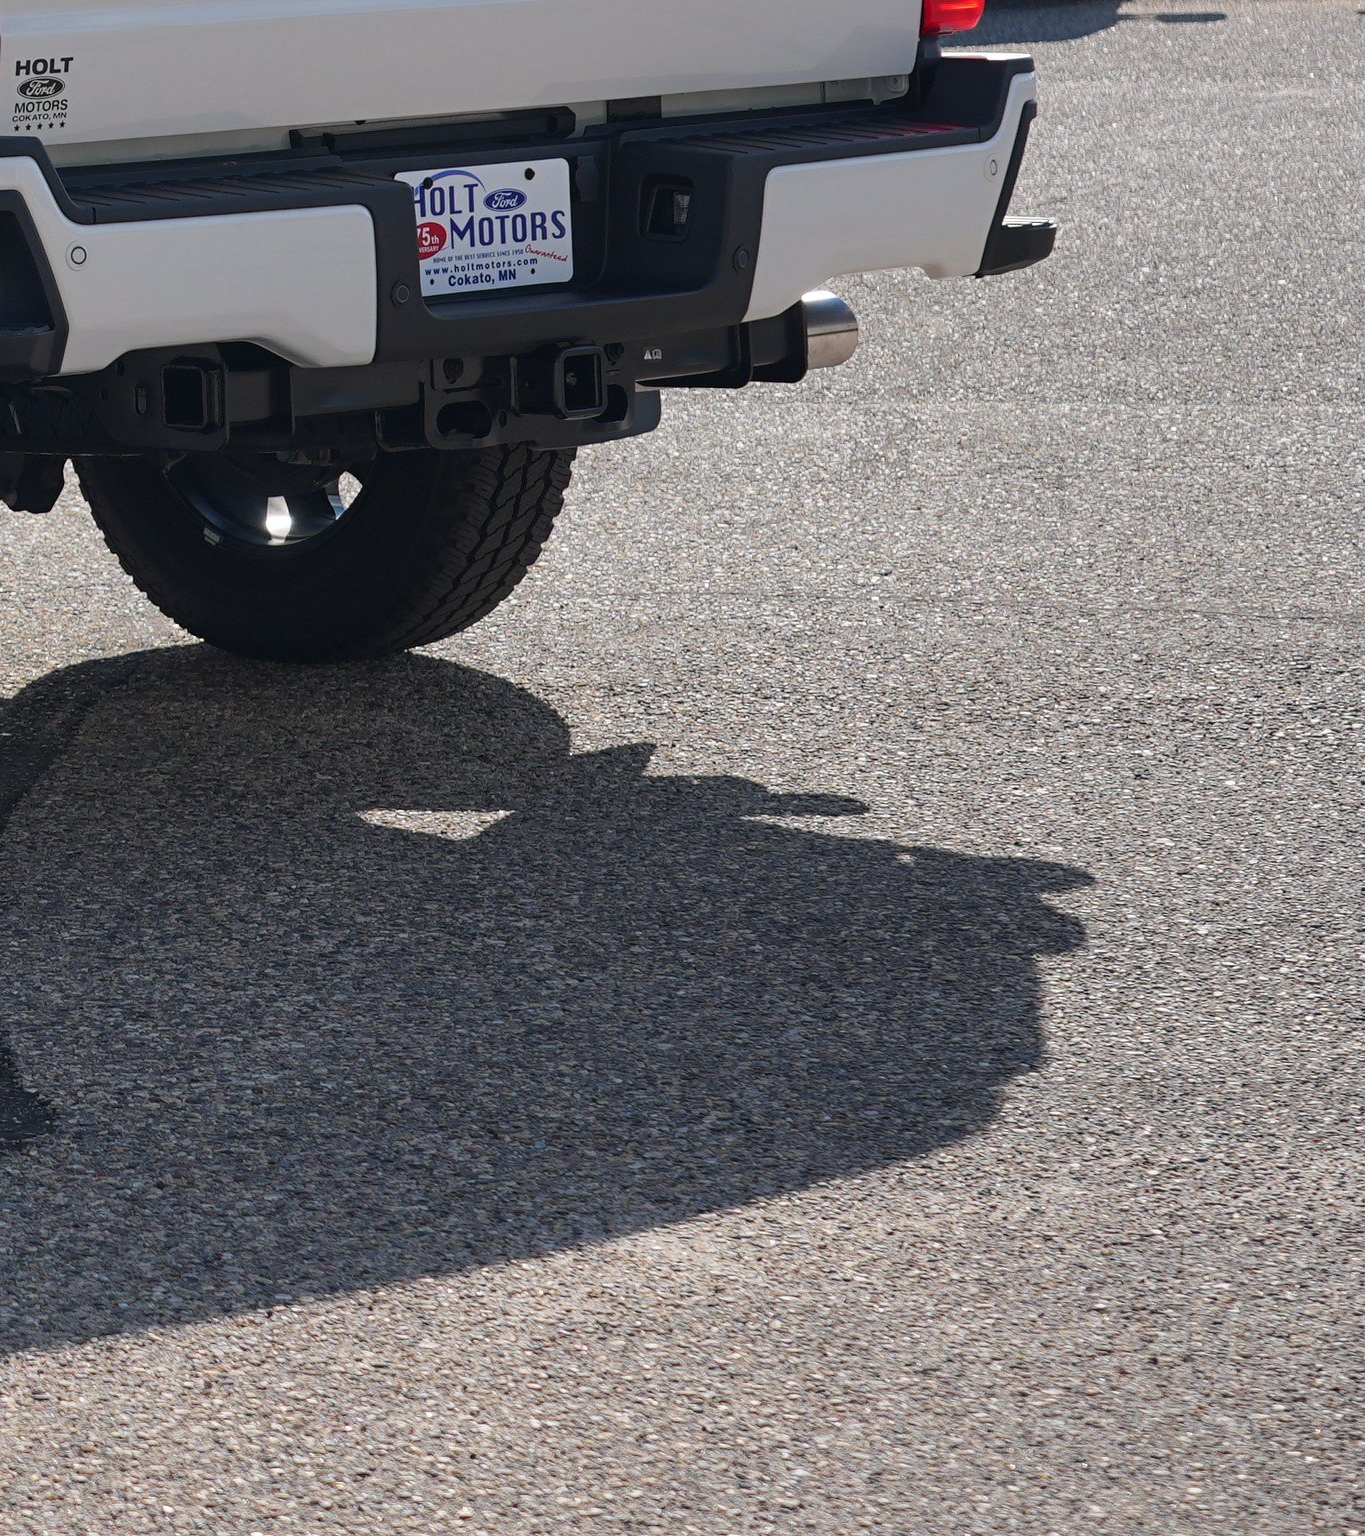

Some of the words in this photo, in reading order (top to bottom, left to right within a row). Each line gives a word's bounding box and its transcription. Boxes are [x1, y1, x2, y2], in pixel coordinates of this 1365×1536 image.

[15, 57, 74, 76] HOLT
[26, 79, 56, 96] Ford
[14, 99, 68, 114] MOTORS
[12, 113, 51, 123] COKATO,
[414, 183, 479, 217] HOLT
[491, 192, 518, 209] Ford
[450, 210, 566, 250] MOTORS
[525, 244, 569, 262] Guaranteed
[425, 257, 538, 276] www.holtmotors.com
[448, 273, 495, 287] Cokato,
[498, 269, 517, 282] MN
